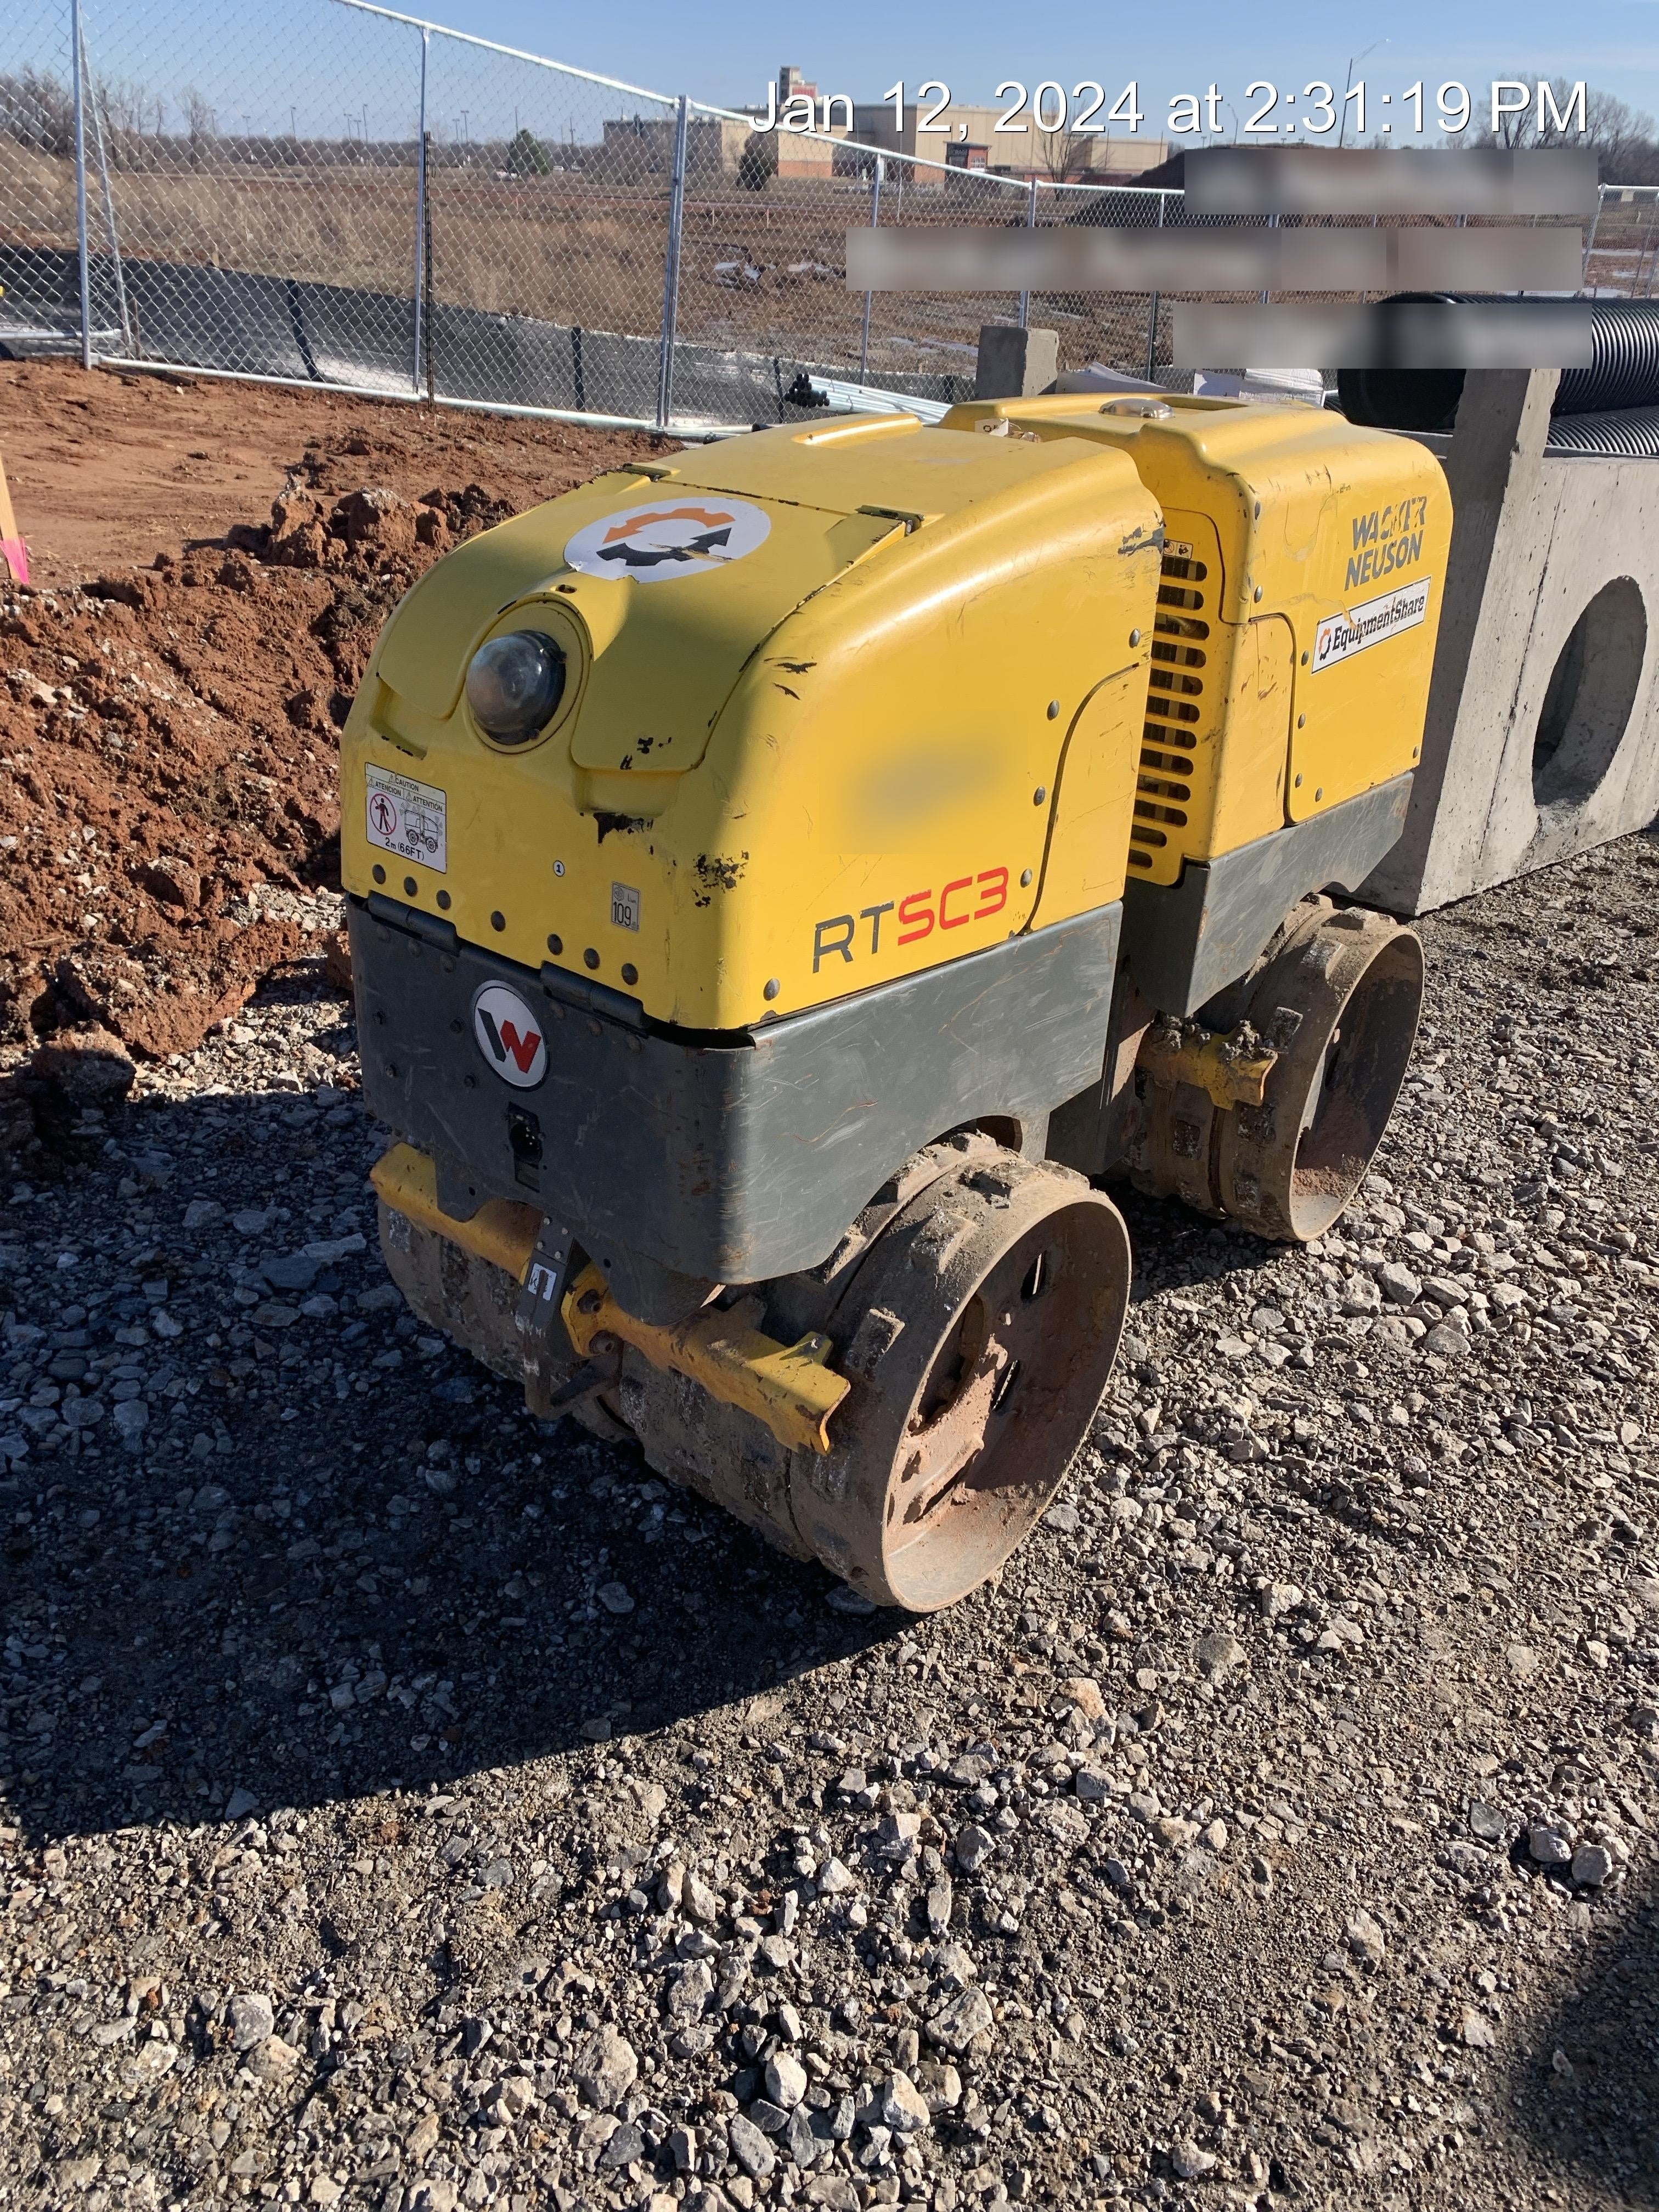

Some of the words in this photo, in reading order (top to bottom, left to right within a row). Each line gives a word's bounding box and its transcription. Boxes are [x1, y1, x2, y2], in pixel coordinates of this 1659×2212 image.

[1352, 495, 1427, 551] WACKER
[1344, 529, 1424, 591] NEUSON
[1332, 594, 1425, 652] EquipmentShare
[395, 777, 419, 792] CAUTION
[614, 901, 631, 927] 109
